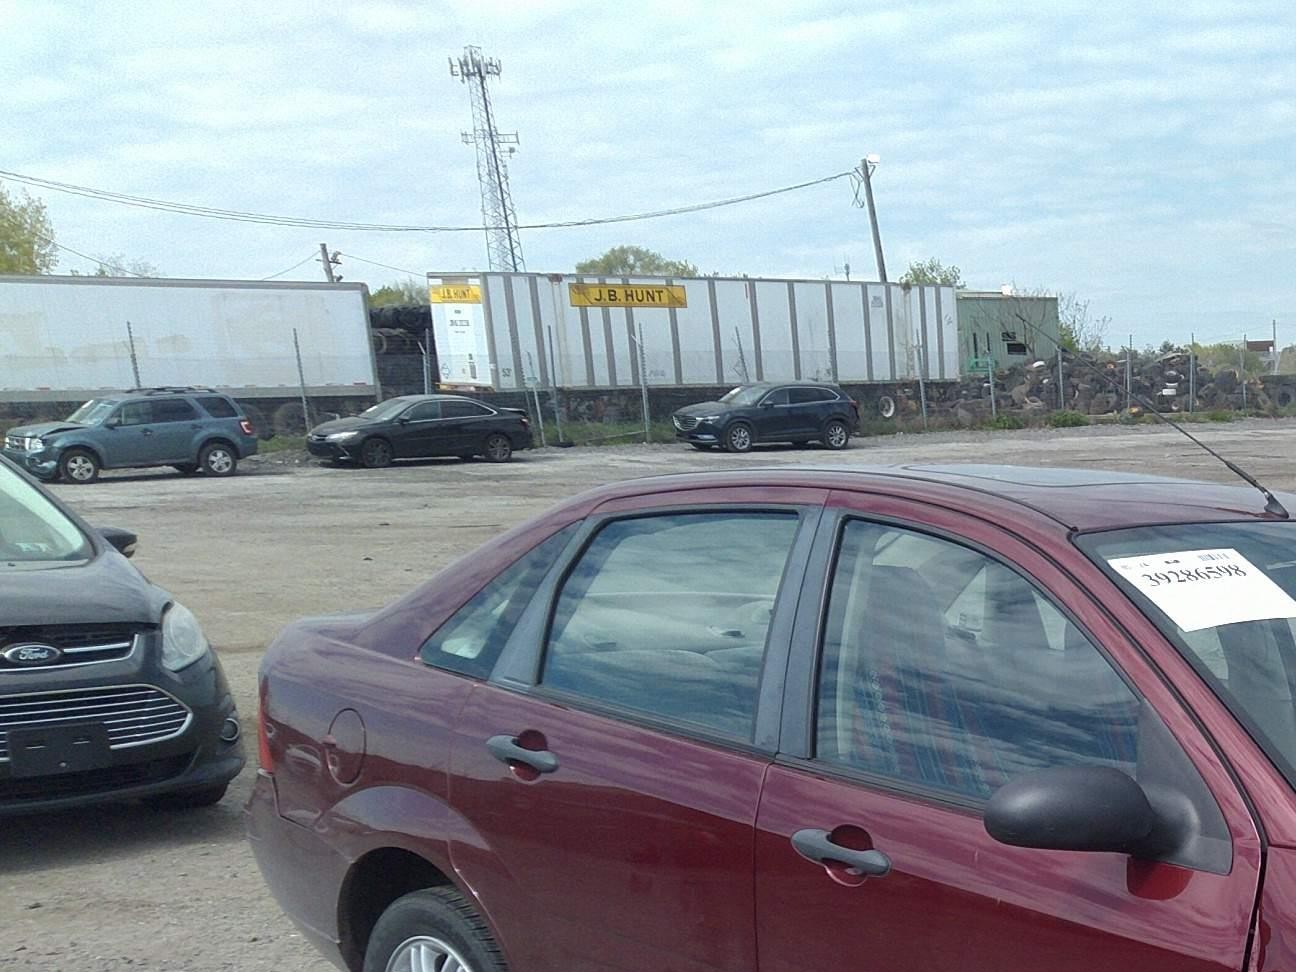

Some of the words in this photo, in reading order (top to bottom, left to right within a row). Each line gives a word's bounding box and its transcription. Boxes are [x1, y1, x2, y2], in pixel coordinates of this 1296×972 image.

[453, 288, 471, 299] HUNT
[594, 288, 621, 302] J.B.
[624, 289, 664, 303] HUNT
[1141, 563, 1247, 587] 39286598
[18, 647, 49, 660] Ford
